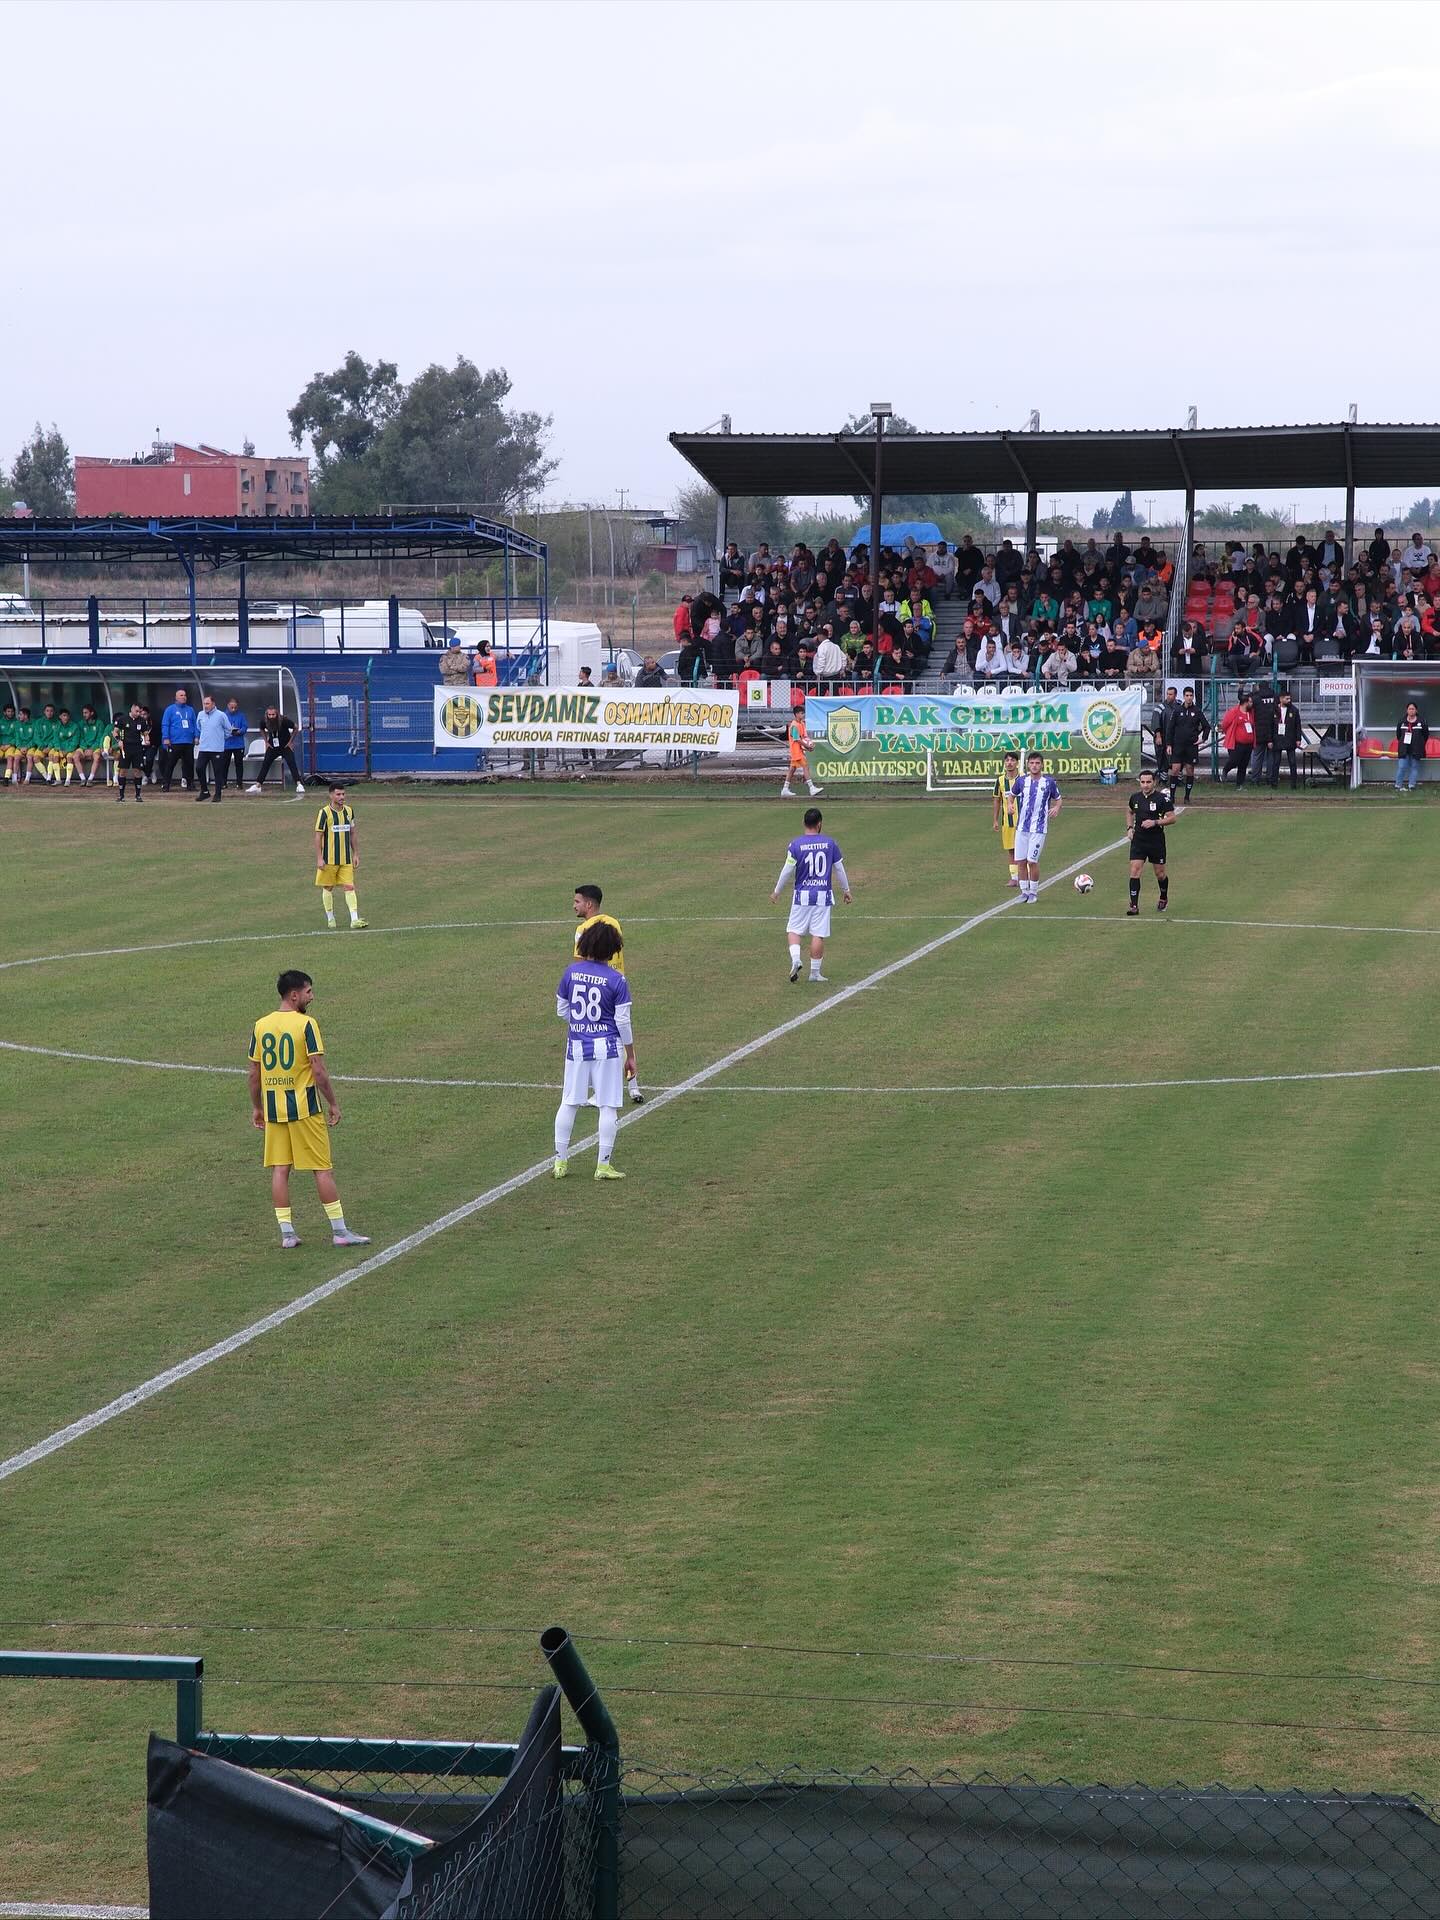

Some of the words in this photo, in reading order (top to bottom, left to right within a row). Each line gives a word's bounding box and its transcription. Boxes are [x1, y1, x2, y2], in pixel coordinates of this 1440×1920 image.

[753, 690, 761, 700] 3
[487, 694, 601, 725] SEVDAMIZ
[604, 695, 733, 728] OSMANİYESPOR
[874, 702, 942, 726] BAK
[949, 699, 1070, 727] GELDİM
[492, 730, 553, 745] ÇUKUROVA
[556, 731, 610, 743] FIRTINASI
[613, 731, 671, 744] TARAFTAR
[672, 730, 720, 745] DERNEĞİ
[875, 729, 1072, 754] YANINDAYIM
[804, 851, 827, 877] 10
[1033, 849, 1039, 857] 9
[571, 984, 602, 1022] 58
[586, 1023, 608, 1033] ALKAN
[261, 1032, 295, 1071] 80
